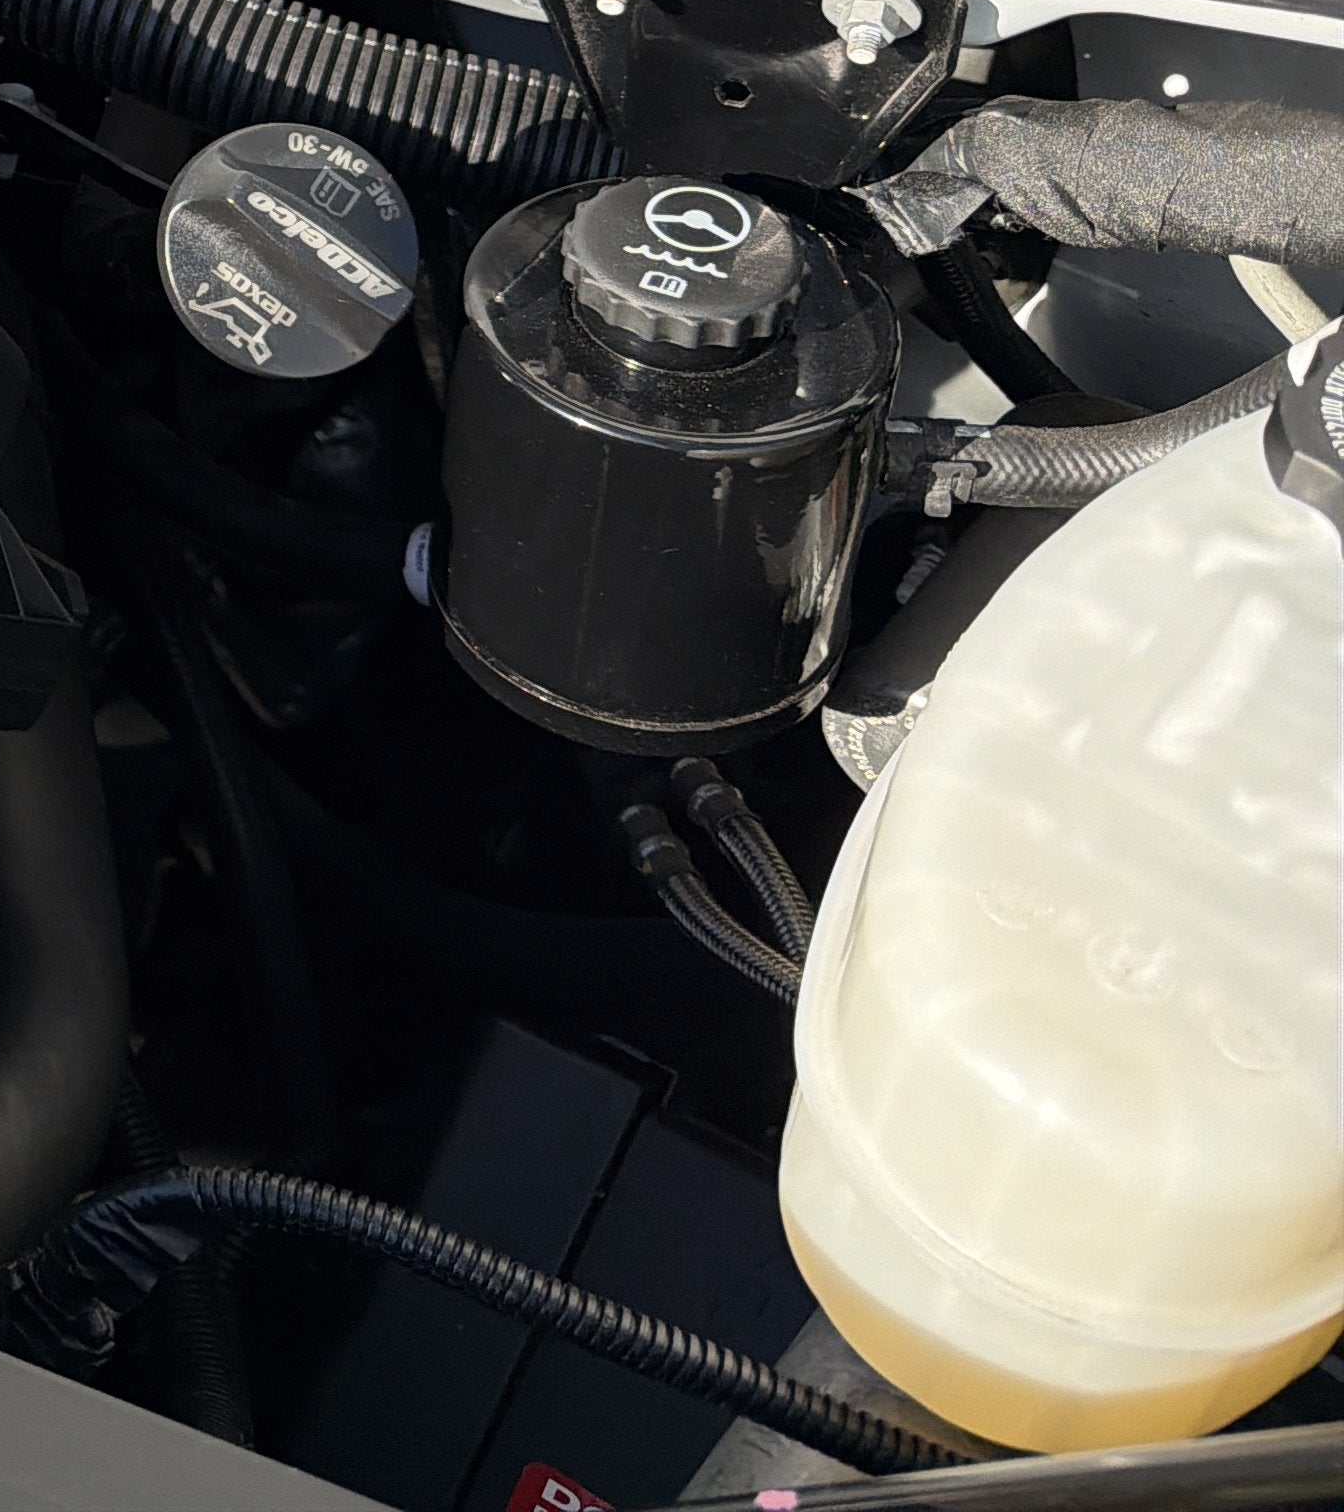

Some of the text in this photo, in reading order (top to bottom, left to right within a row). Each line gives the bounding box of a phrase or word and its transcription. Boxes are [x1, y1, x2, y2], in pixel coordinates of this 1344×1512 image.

[288, 132, 400, 222] SAE 5W-30
[247, 191, 396, 299] ACDelco
[212, 261, 298, 328] dexos
